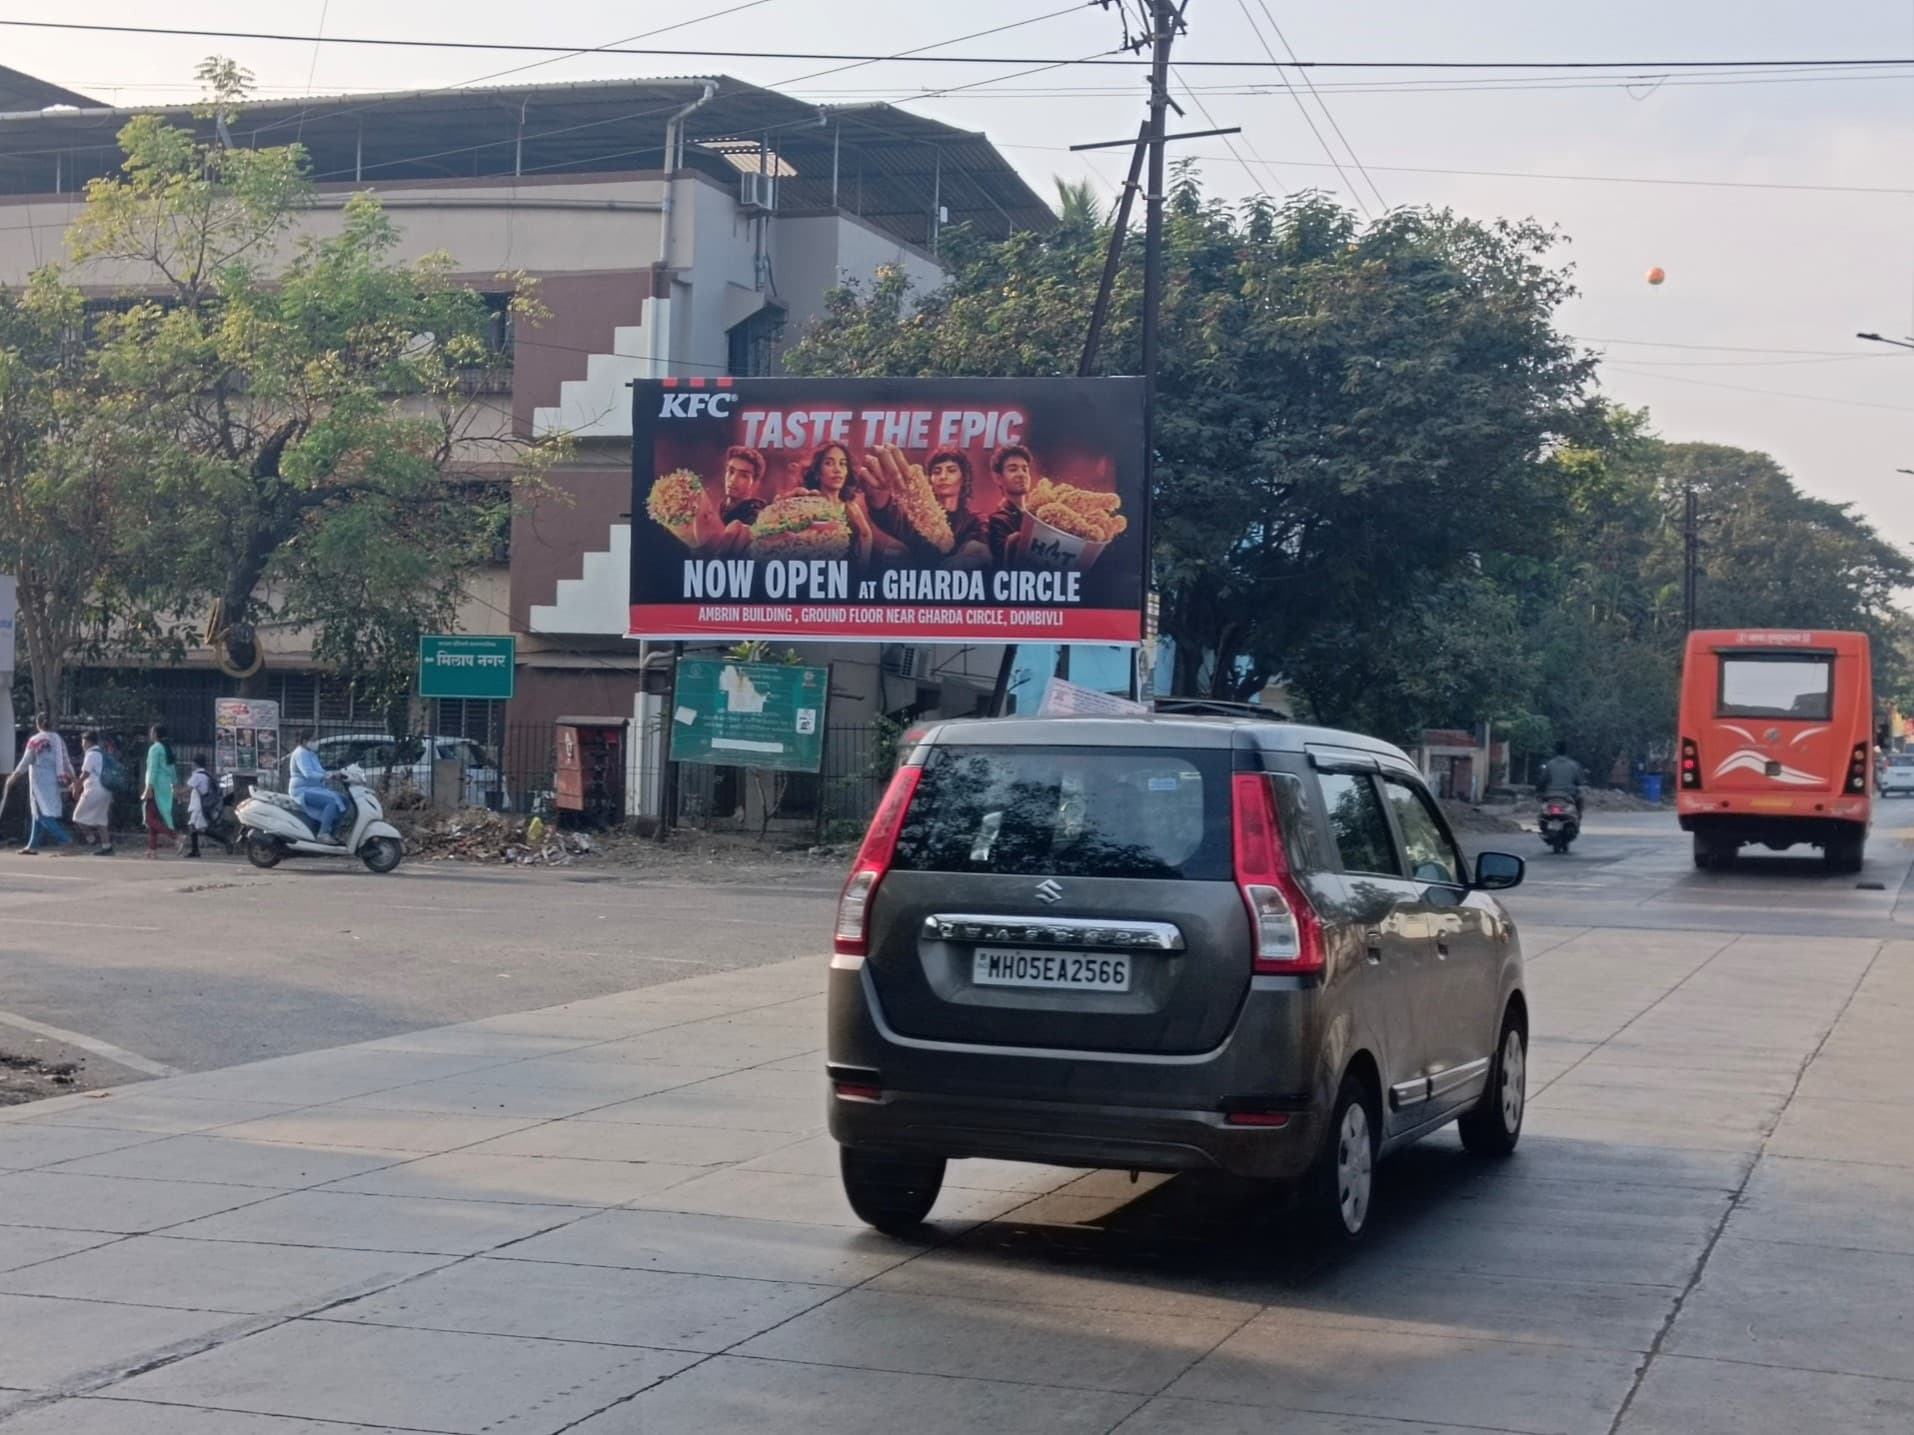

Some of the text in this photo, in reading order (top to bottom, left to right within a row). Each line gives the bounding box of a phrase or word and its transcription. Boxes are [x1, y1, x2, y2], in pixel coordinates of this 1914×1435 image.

[742, 411, 1023, 448] TASTE THE EPIC
[683, 559, 1080, 602] NOW OPEN AT GHARDA CIRCLE
[698, 607, 739, 622] AMBRIN
[801, 608, 846, 623] GROUND
[850, 608, 883, 623] FLOOR
[886, 609, 915, 623] NEAR
[918, 609, 963, 624] GHARDA
[966, 610, 1007, 626] CIRCLE,
[1010, 611, 1063, 625] DOMBIVLI
[436, 650, 506, 667] मिलाप नगर
[988, 954, 1126, 985] MH05EA2566
